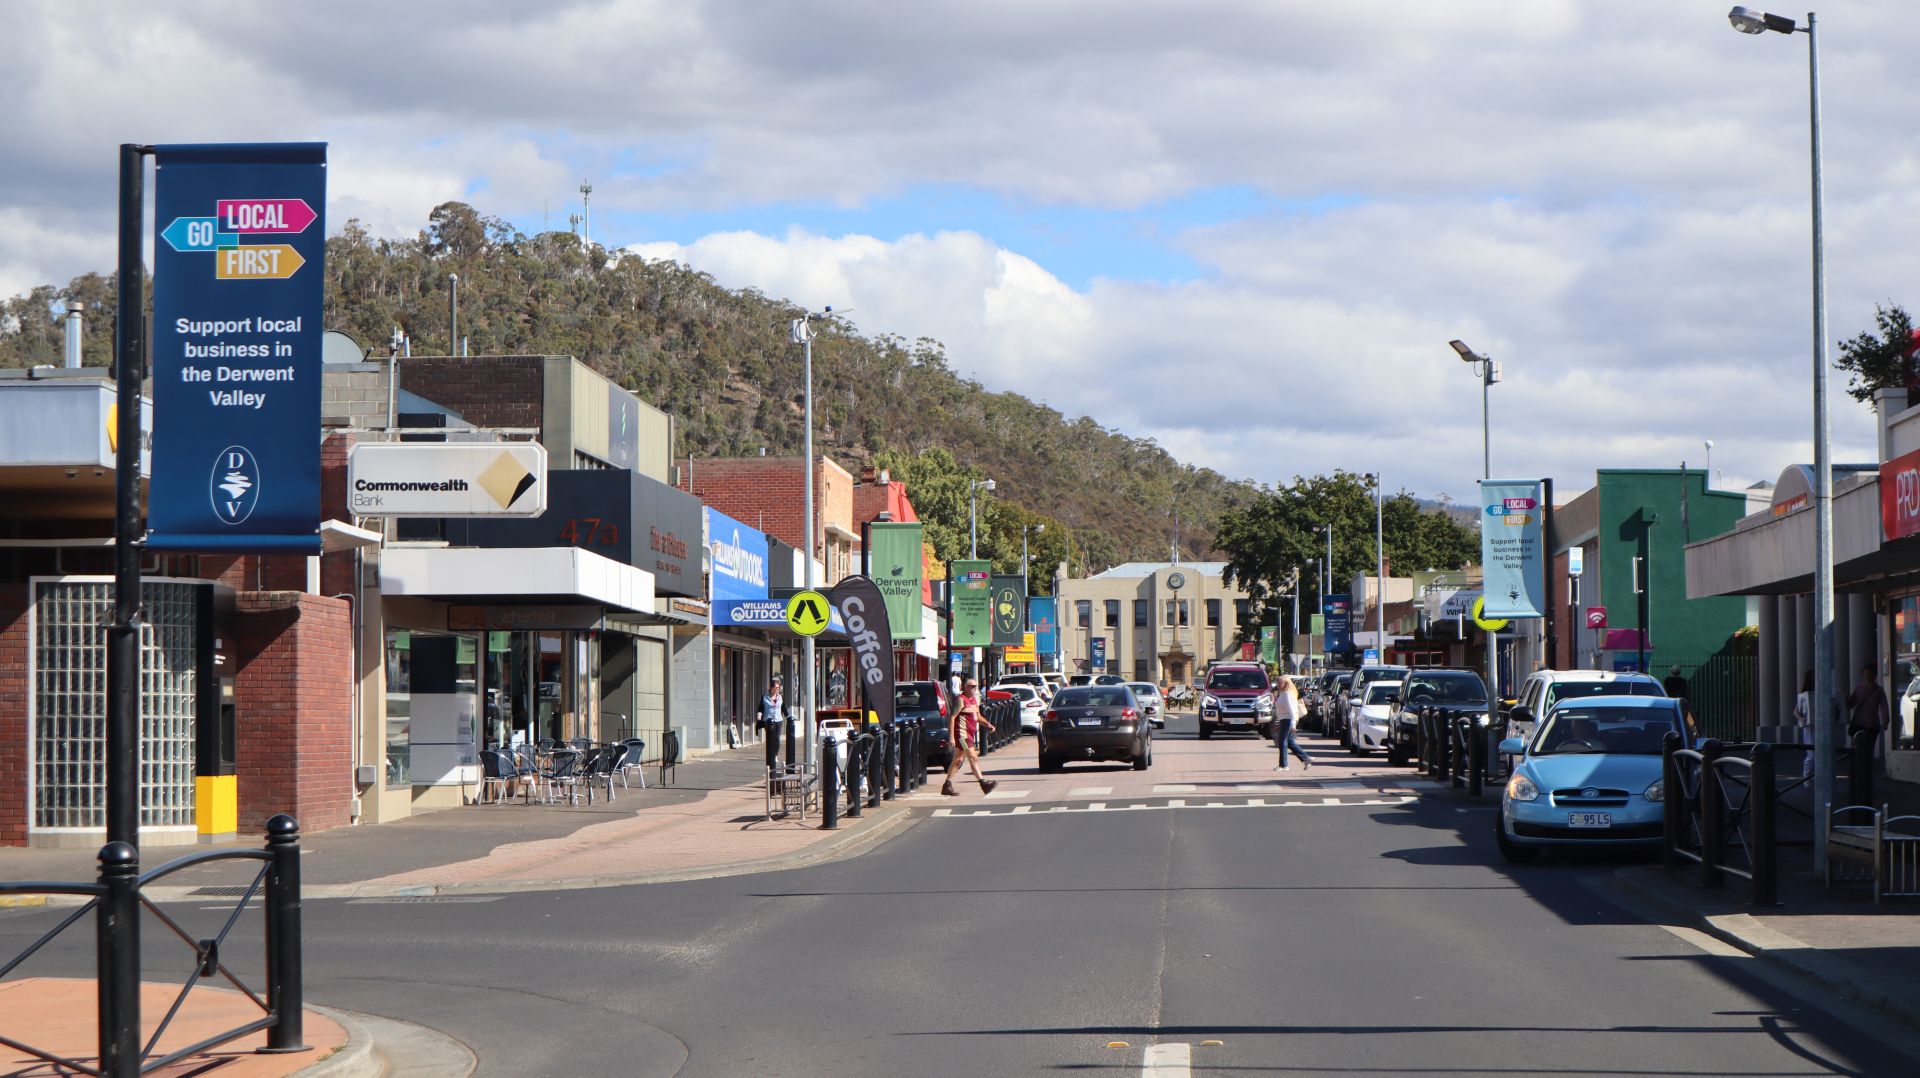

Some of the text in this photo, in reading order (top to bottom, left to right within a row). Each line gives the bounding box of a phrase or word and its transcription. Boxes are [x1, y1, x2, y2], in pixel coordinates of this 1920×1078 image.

[187, 204, 289, 246] GO LOCAL
[227, 249, 282, 275] FIRST
[176, 316, 302, 337] Support local
[184, 340, 292, 358] business in
[182, 366, 295, 382] the Derwent
[209, 389, 266, 409] Valley
[227, 452, 244, 469] D
[355, 479, 469, 492] Commonwealth
[354, 494, 384, 506] Bank
[1896, 468, 1920, 521] PRO
[225, 501, 242, 518] V
[1492, 499, 1529, 515] GO LOCAL
[1506, 515, 1526, 525] FIRST
[560, 517, 620, 546] 47a
[1503, 562, 1523, 570] Valley
[875, 578, 918, 587] Derwent
[882, 587, 913, 597] Valley
[1004, 591, 1013, 602] D
[742, 602, 782, 610] WILLIAMS
[1446, 608, 1466, 616] WIS
[1004, 619, 1013, 630] V
[842, 596, 884, 685] Coffee
